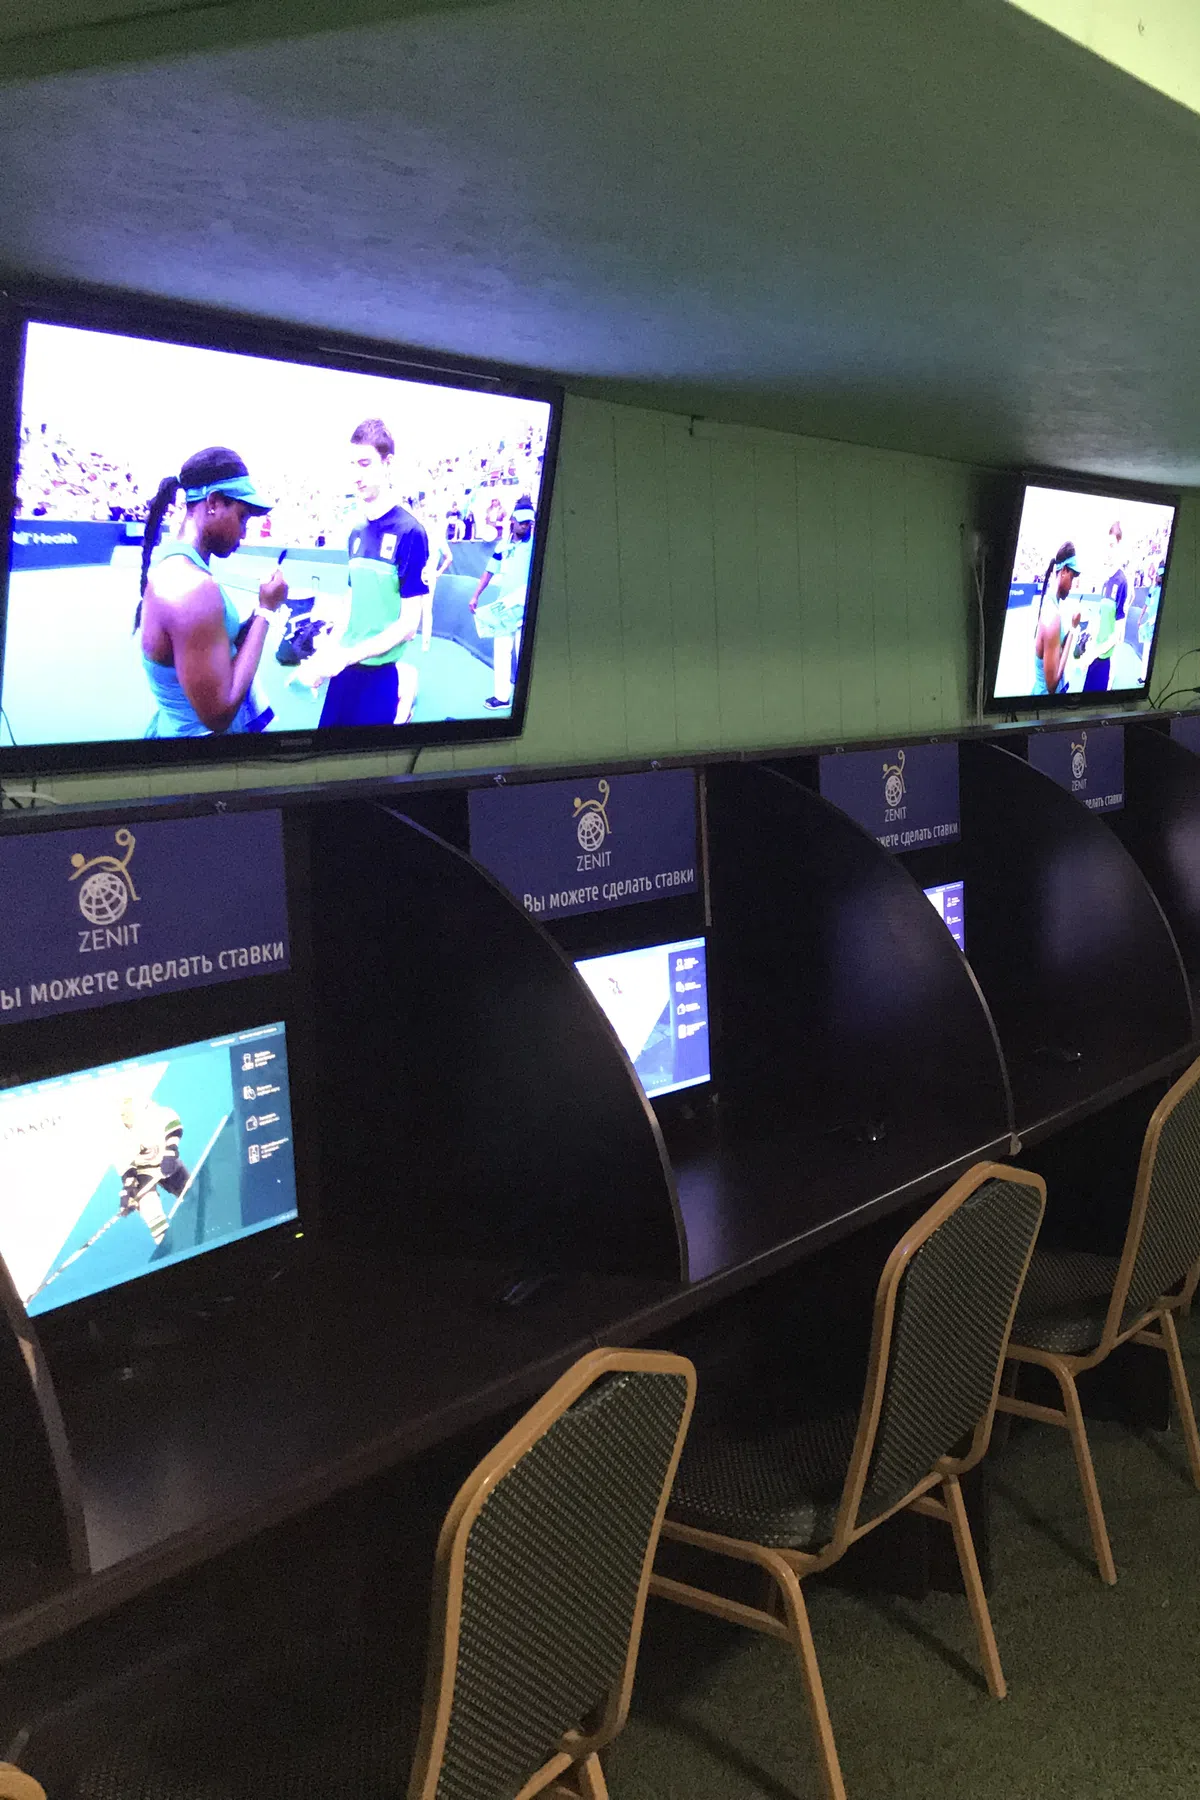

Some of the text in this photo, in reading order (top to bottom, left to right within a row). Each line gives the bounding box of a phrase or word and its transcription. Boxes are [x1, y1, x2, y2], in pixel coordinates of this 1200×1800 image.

[1071, 778, 1088, 792] ZENIT
[884, 806, 907, 823] ZENIT
[900, 827, 932, 847] сделать
[933, 822, 958, 838] ставки
[577, 851, 612, 872] ZENIT
[523, 868, 694, 912] Вы можете сделать ставки
[78, 923, 141, 953] ZENIT
[0, 941, 285, 1010] ы можете сделать ставки
